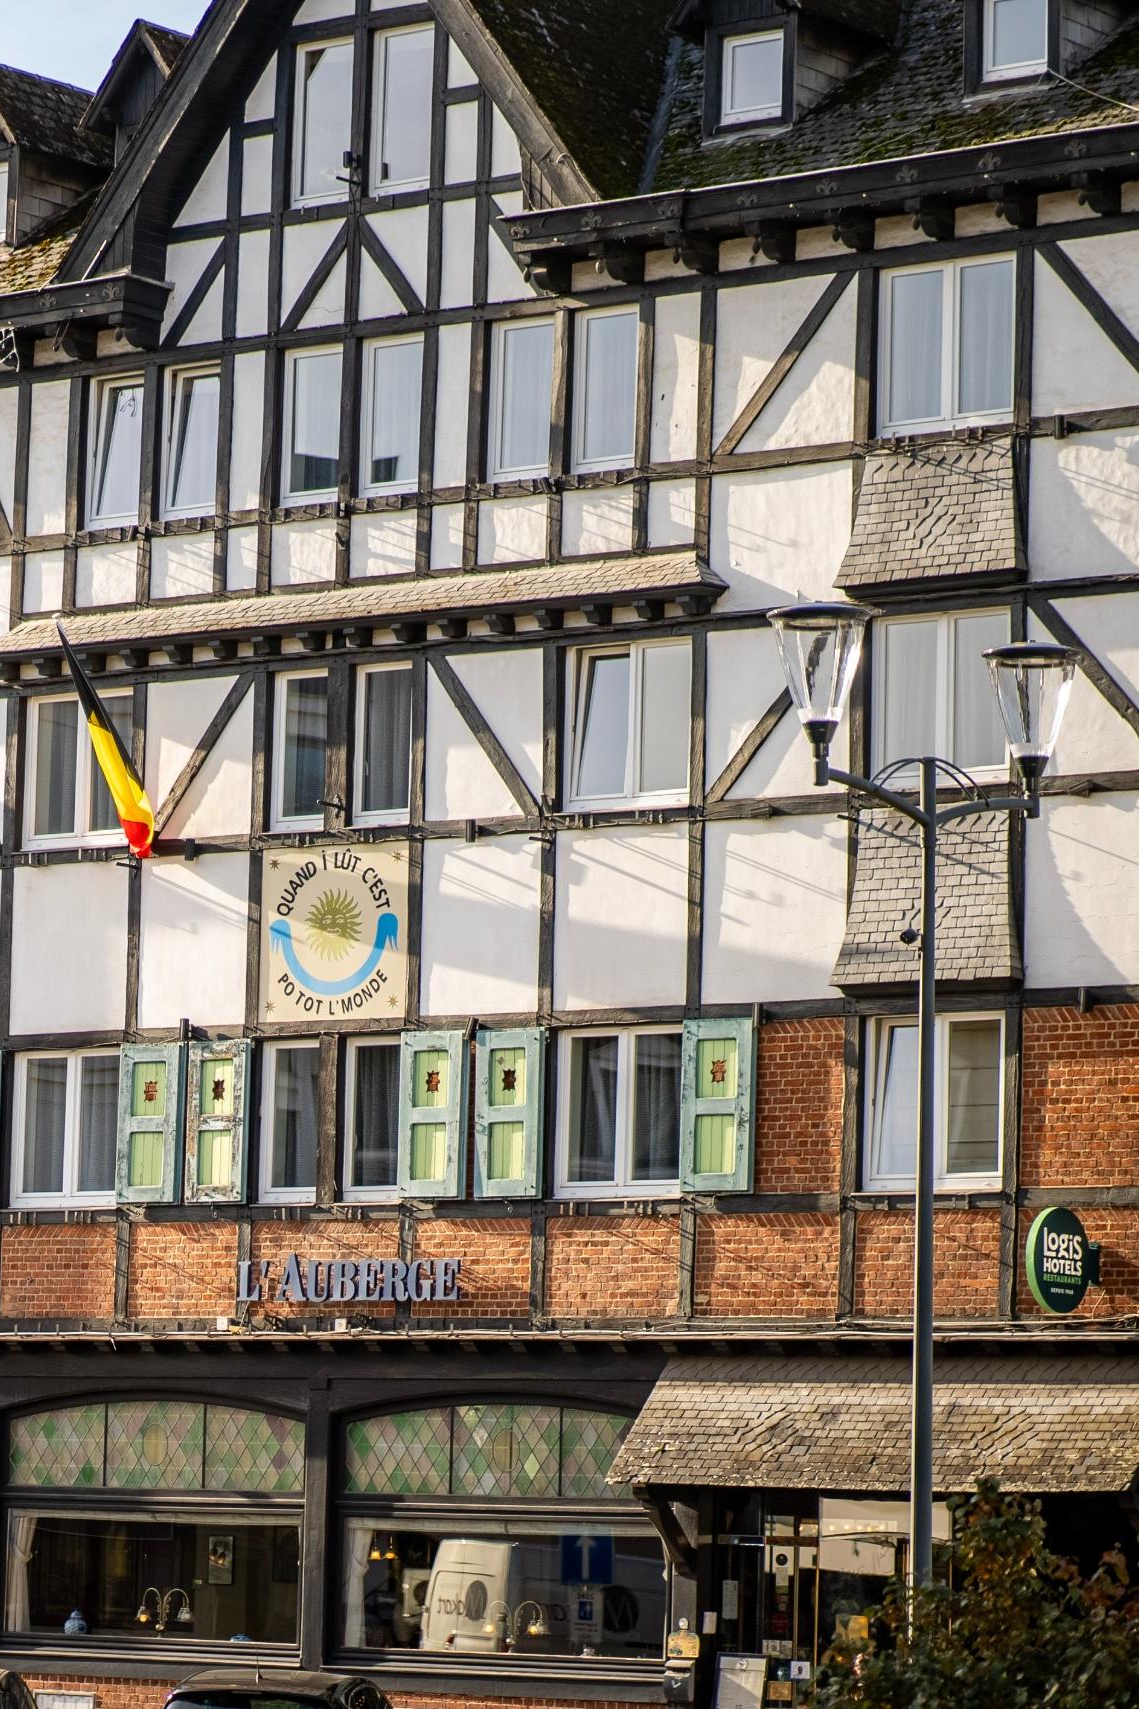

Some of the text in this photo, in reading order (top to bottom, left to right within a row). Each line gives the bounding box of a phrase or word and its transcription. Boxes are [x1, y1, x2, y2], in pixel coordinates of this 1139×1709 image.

[276, 860, 317, 917] QUAND
[334, 848, 362, 873] LÛT
[362, 867, 391, 910] C'EST
[277, 968, 388, 1016] PO TOT L'MONDE
[236, 1251, 461, 1303] L'AUBERGE
[1043, 1257, 1082, 1276] HOTELS
[1043, 1273, 1082, 1285] RESTAURANTS
